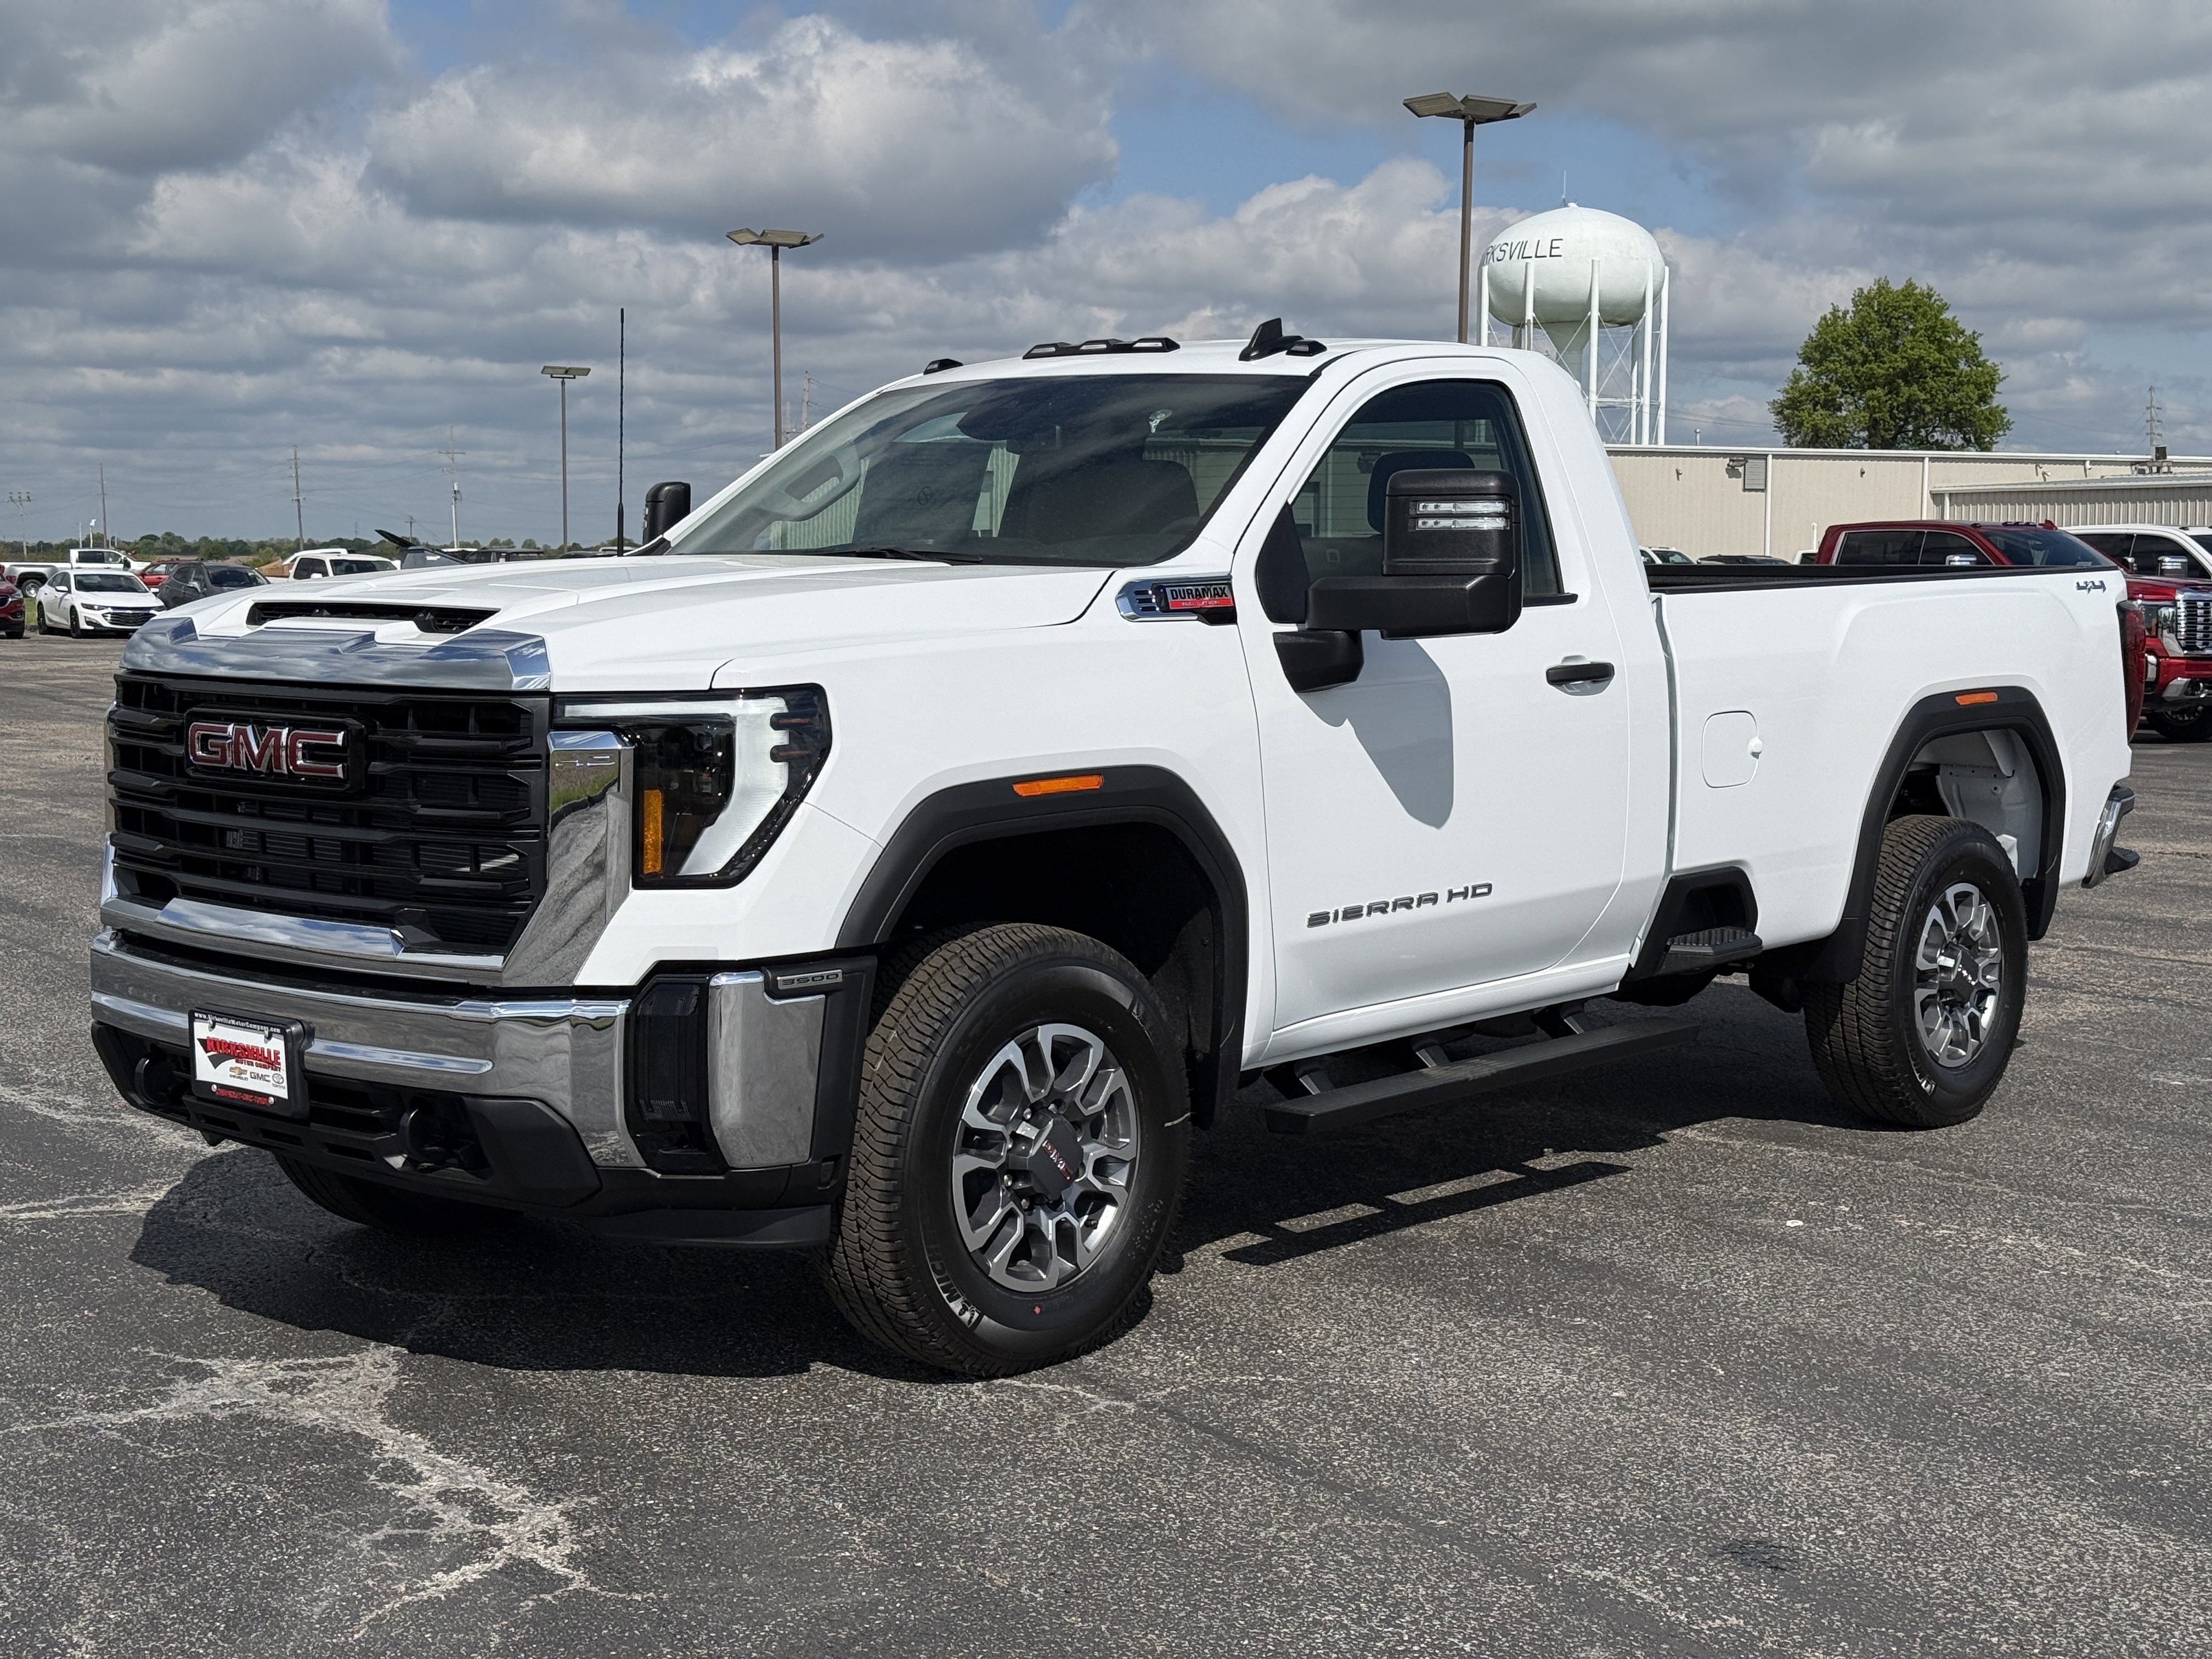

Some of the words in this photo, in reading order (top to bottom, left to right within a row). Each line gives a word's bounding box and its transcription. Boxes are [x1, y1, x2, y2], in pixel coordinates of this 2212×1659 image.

[1170, 586, 1229, 600] DURAMAX
[189, 721, 346, 779] GMC
[1306, 891, 1439, 928] SIERRA
[1447, 882, 1493, 903] HD
[782, 973, 839, 986] 3500
[206, 1036, 281, 1064] KIRKSVILLE
[235, 1058, 254, 1067] MOTOR
[250, 1071, 271, 1083] GMC
